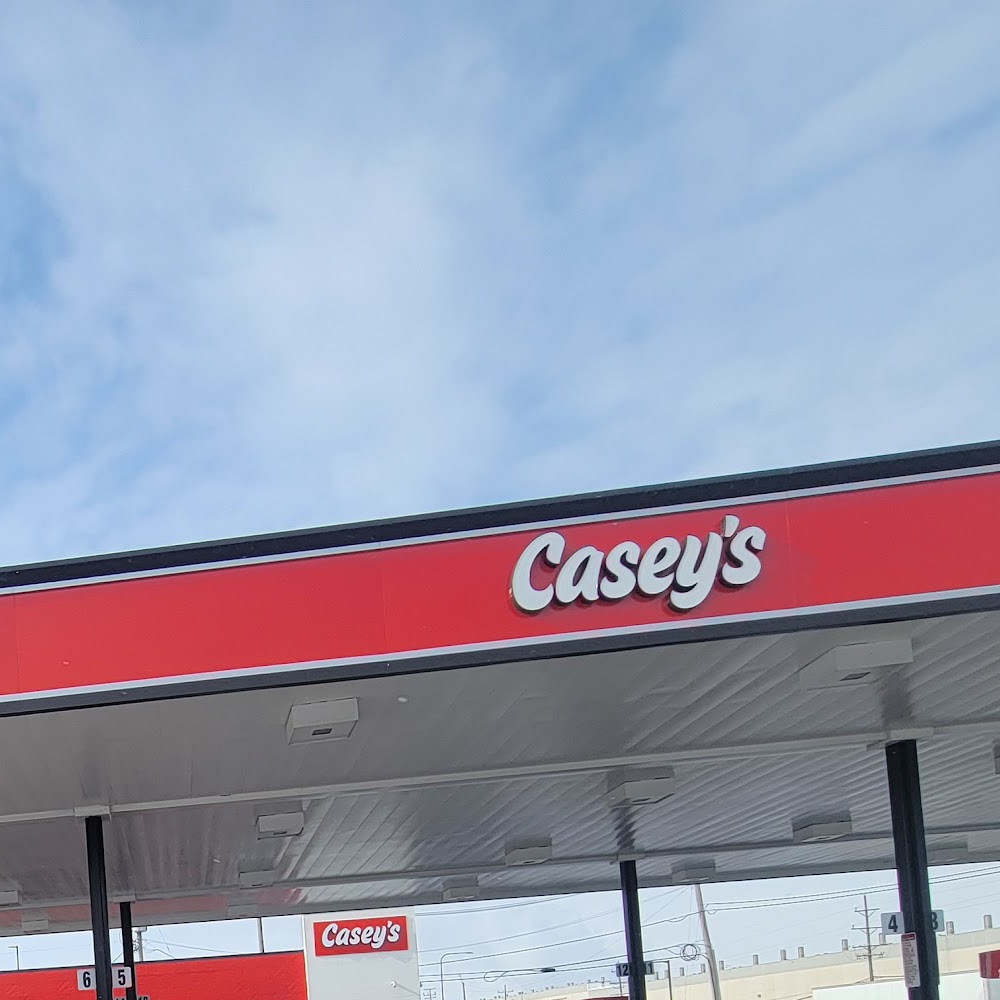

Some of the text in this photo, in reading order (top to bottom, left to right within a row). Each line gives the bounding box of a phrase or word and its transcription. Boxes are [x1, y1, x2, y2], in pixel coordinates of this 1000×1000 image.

[511, 514, 767, 613] Casey's
[887, 914, 899, 933] 4
[321, 920, 401, 949] Casey's
[117, 969, 126, 986] 5
[616, 963, 629, 976] 12
[82, 970, 91, 988] 6
